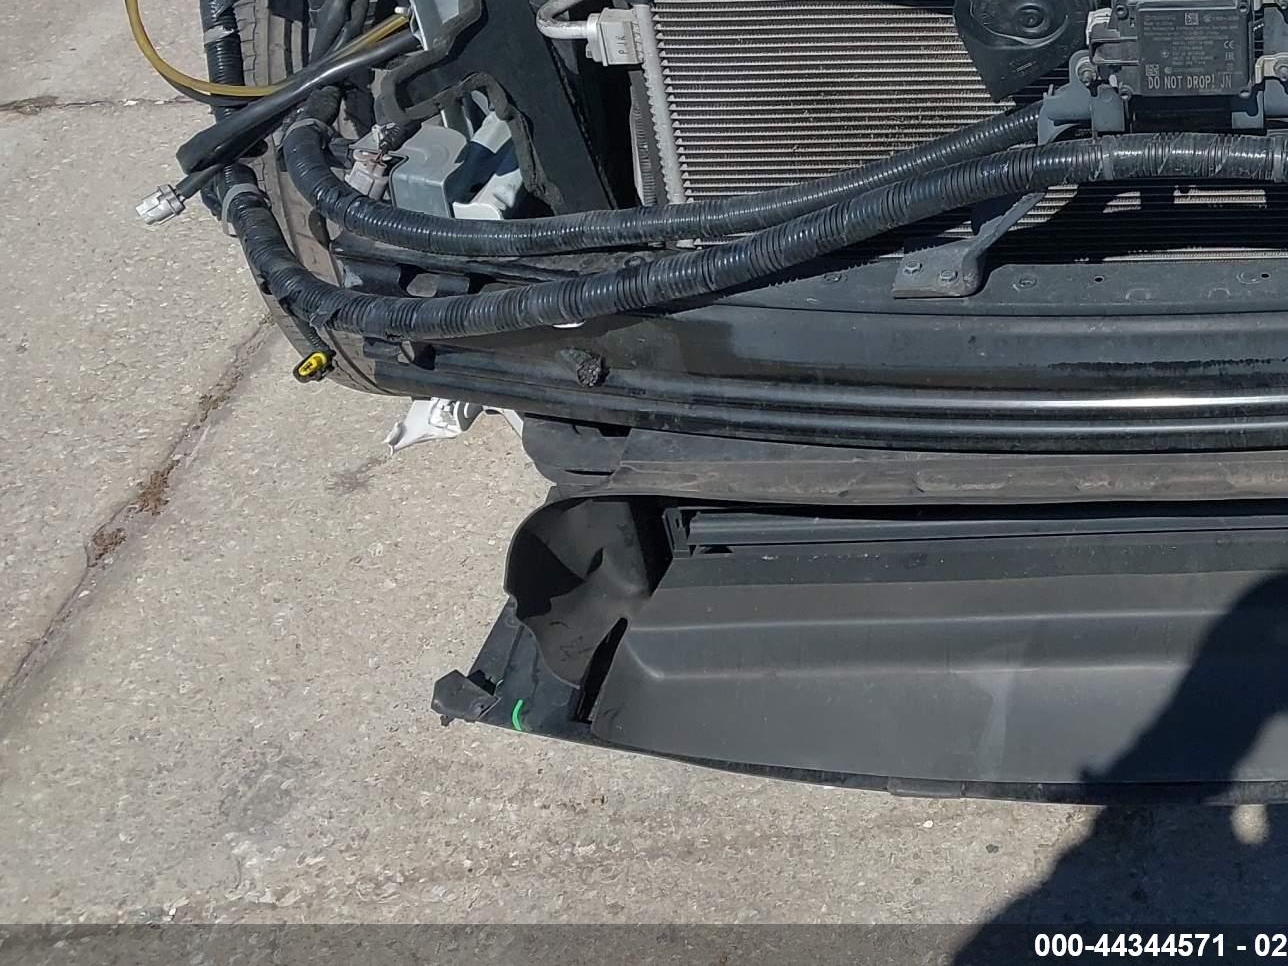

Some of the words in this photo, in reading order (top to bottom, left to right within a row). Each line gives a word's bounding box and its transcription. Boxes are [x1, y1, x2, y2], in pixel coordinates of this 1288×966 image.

[1148, 76, 1160, 89] DO
[1165, 75, 1184, 89] NOT
[1187, 74, 1215, 89] DROP!
